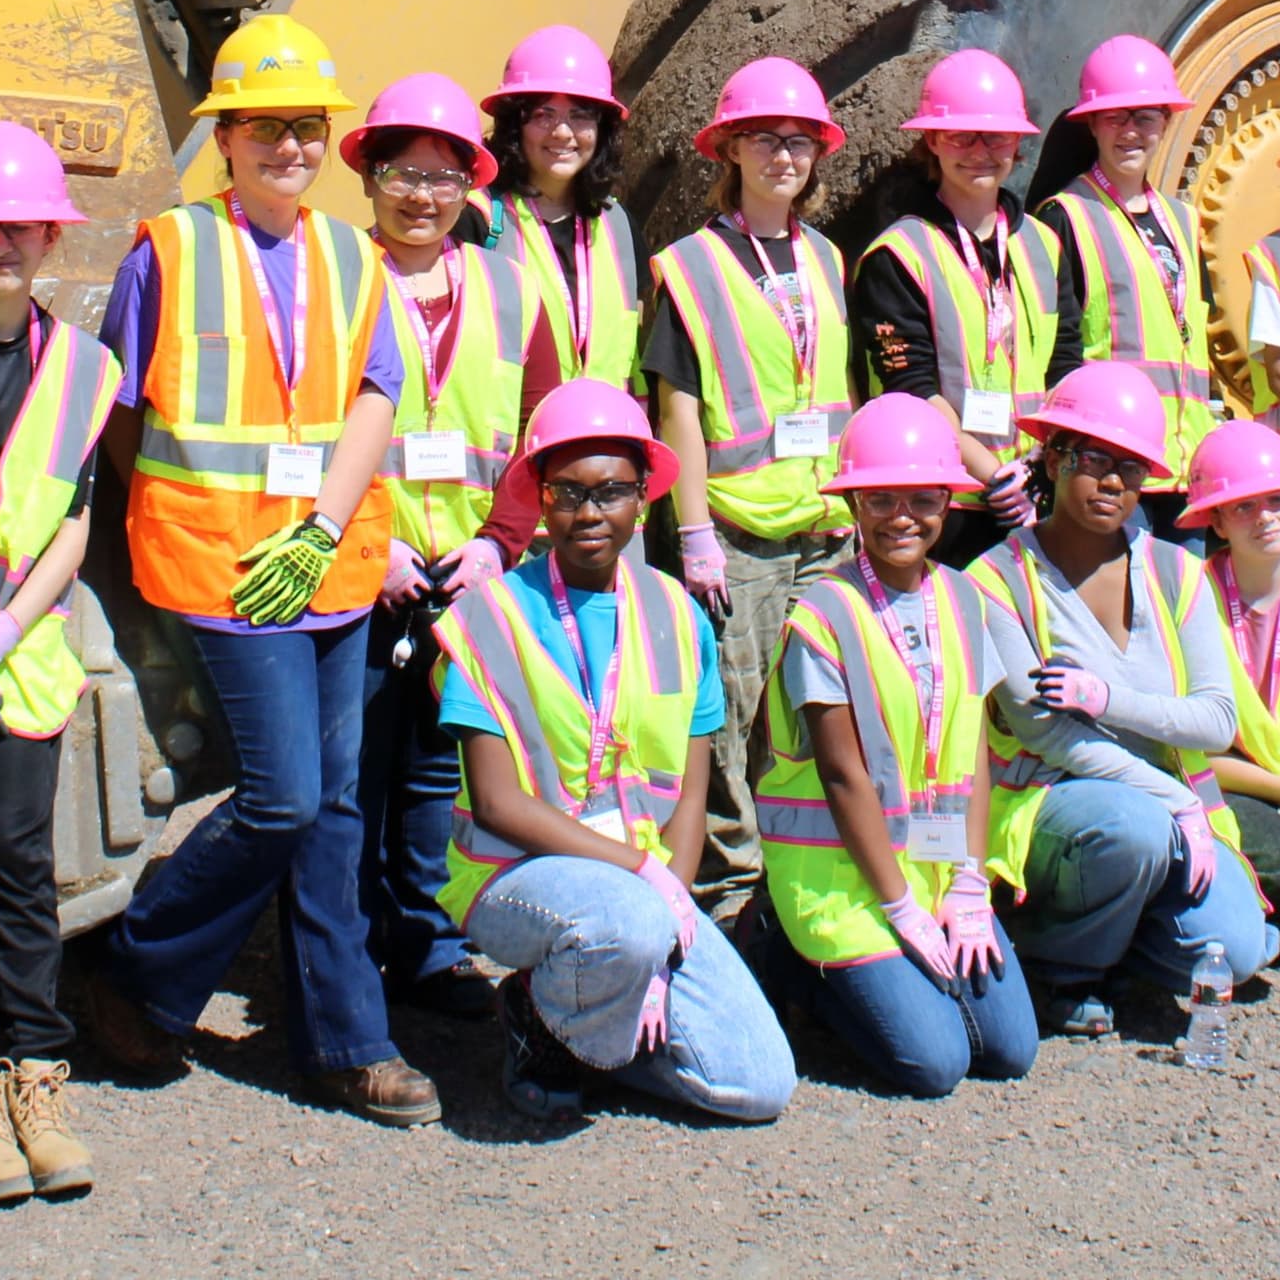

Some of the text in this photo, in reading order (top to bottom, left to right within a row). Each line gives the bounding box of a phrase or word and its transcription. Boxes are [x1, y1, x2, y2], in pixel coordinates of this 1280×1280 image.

[1092, 168, 1111, 192] GIRL
[859, 556, 878, 584] GIRL
[557, 599, 573, 629] GIRL
[925, 594, 937, 624] GIRL
[1230, 602, 1243, 627] GIRL
[894, 636, 914, 666] GIRL
[933, 682, 944, 712] GIRL
[592, 731, 607, 763] GIRL
